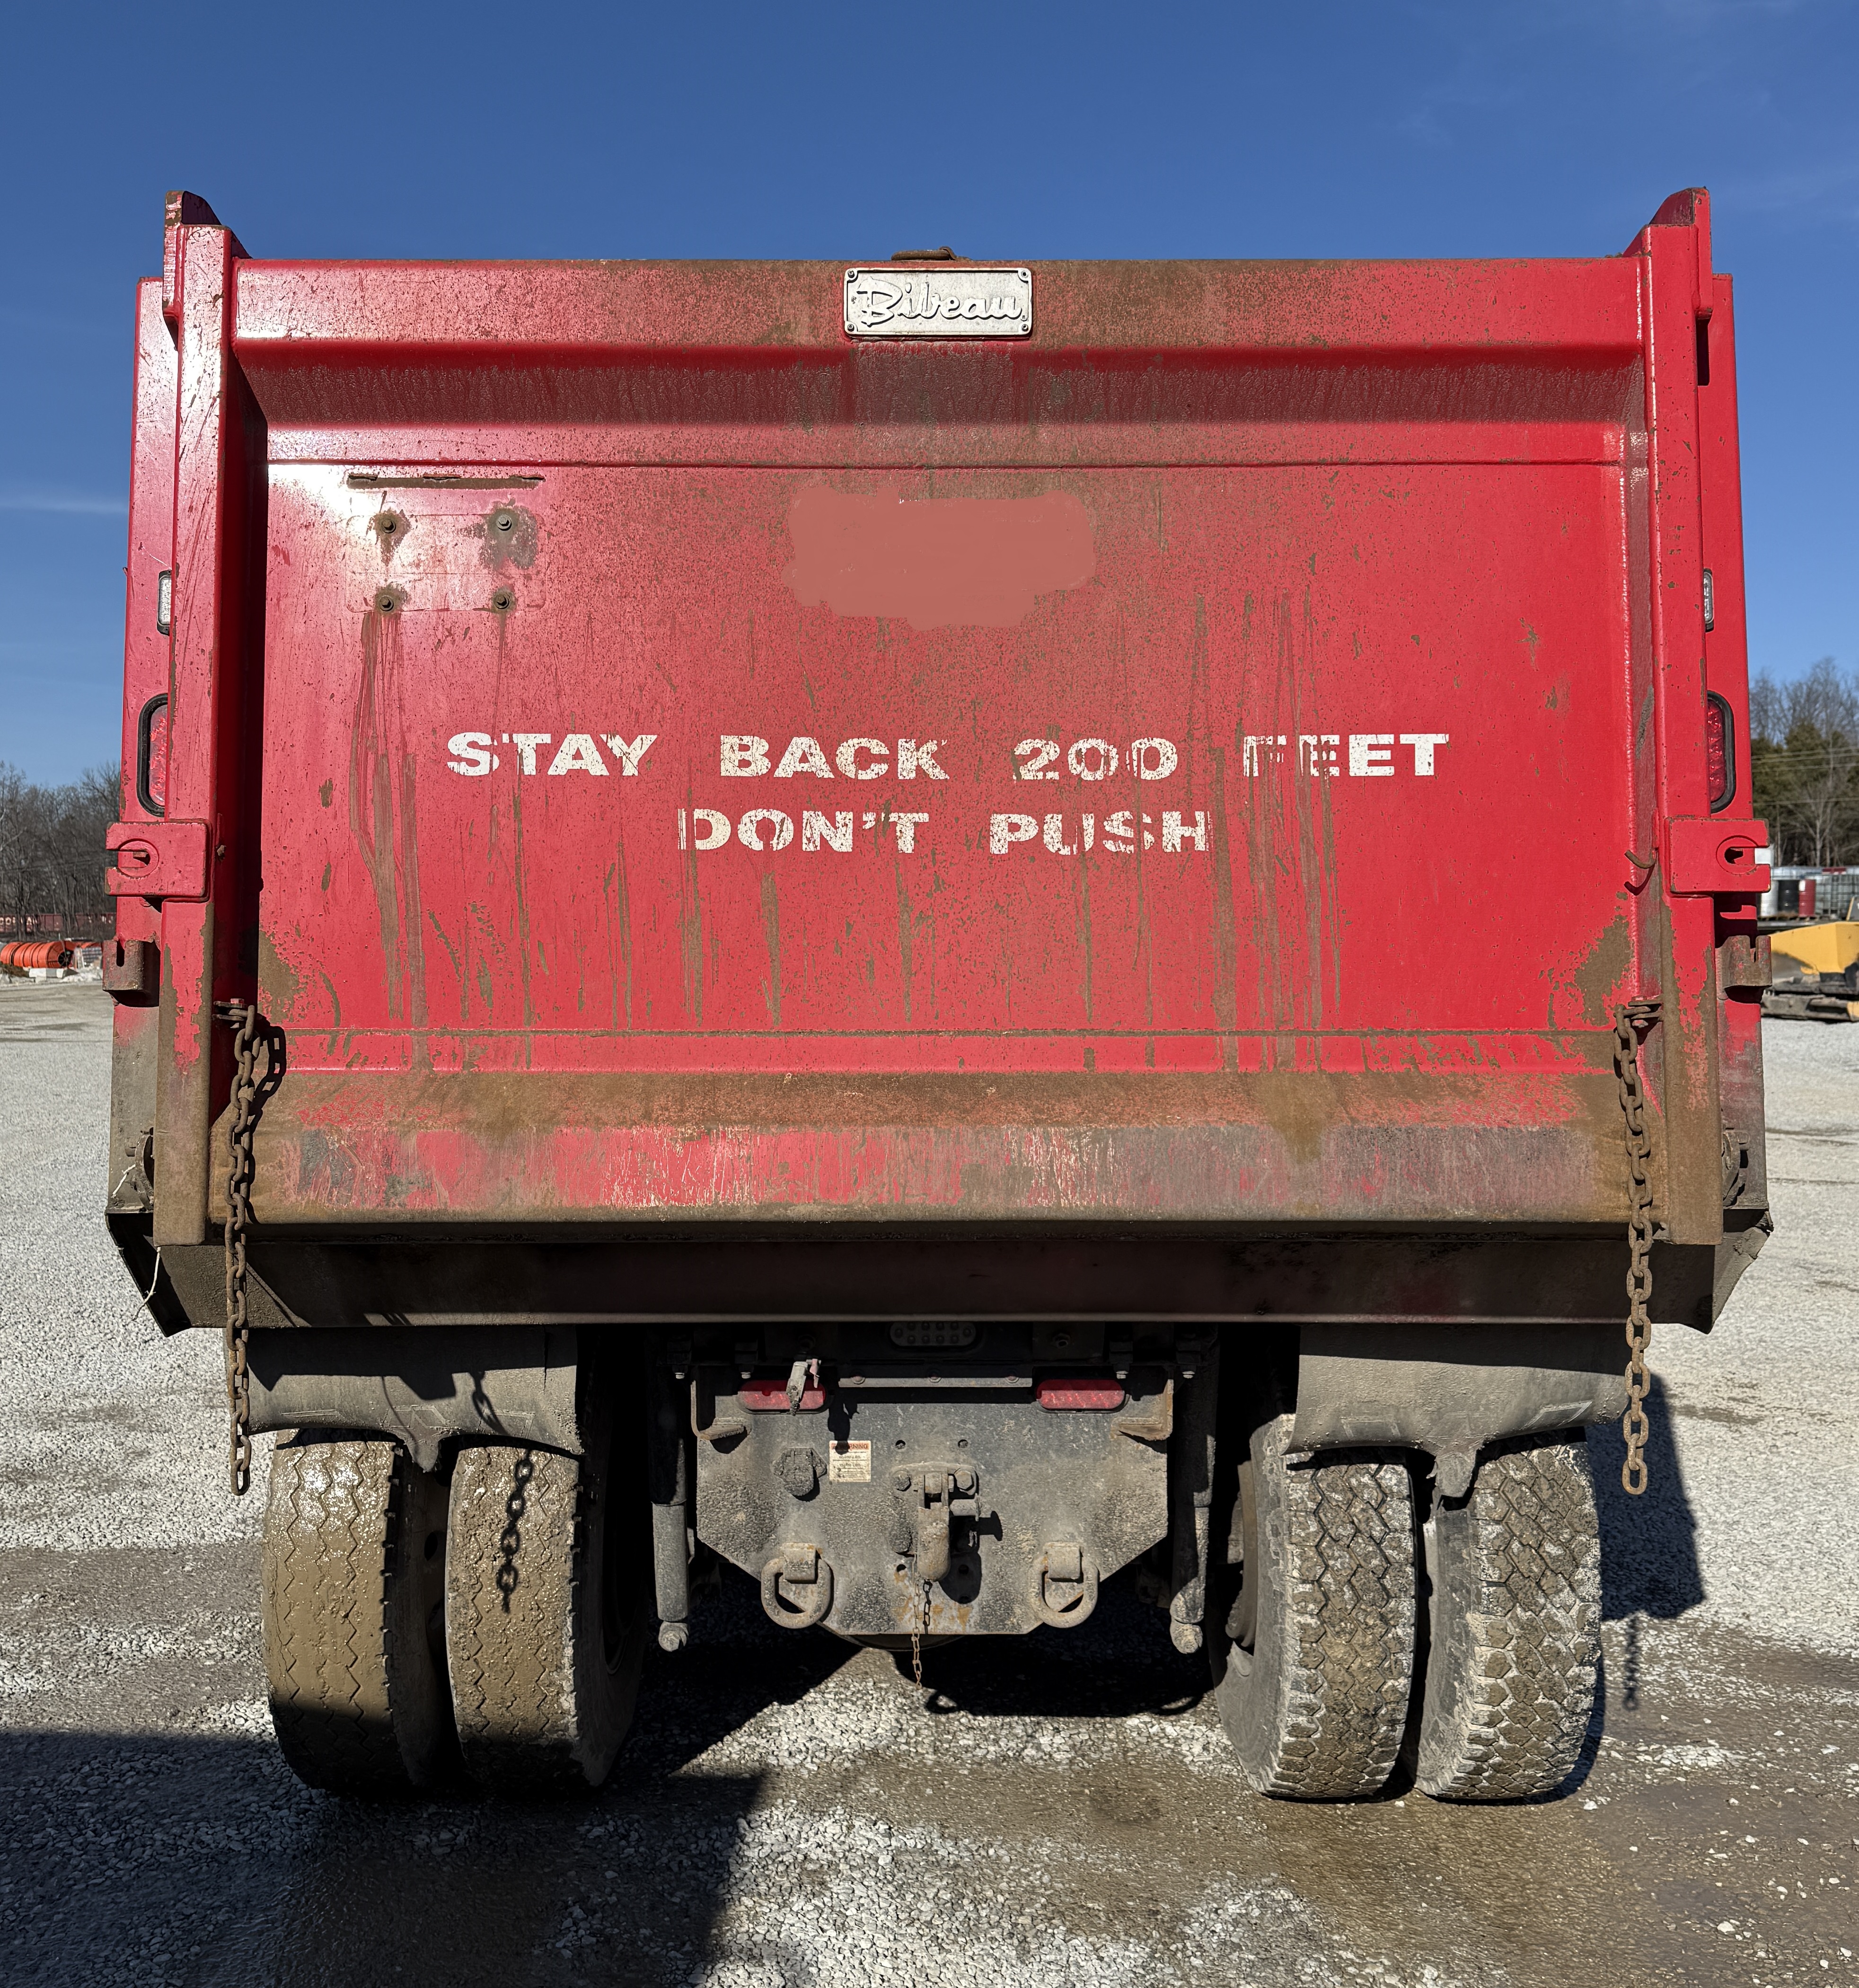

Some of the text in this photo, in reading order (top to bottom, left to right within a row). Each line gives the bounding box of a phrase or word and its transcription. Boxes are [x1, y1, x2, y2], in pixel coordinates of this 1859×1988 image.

[856, 276, 1022, 327] Bibeau
[447, 732, 1449, 781] STAY BACK 200 FEET
[678, 808, 1212, 855] DON'T PUSH
